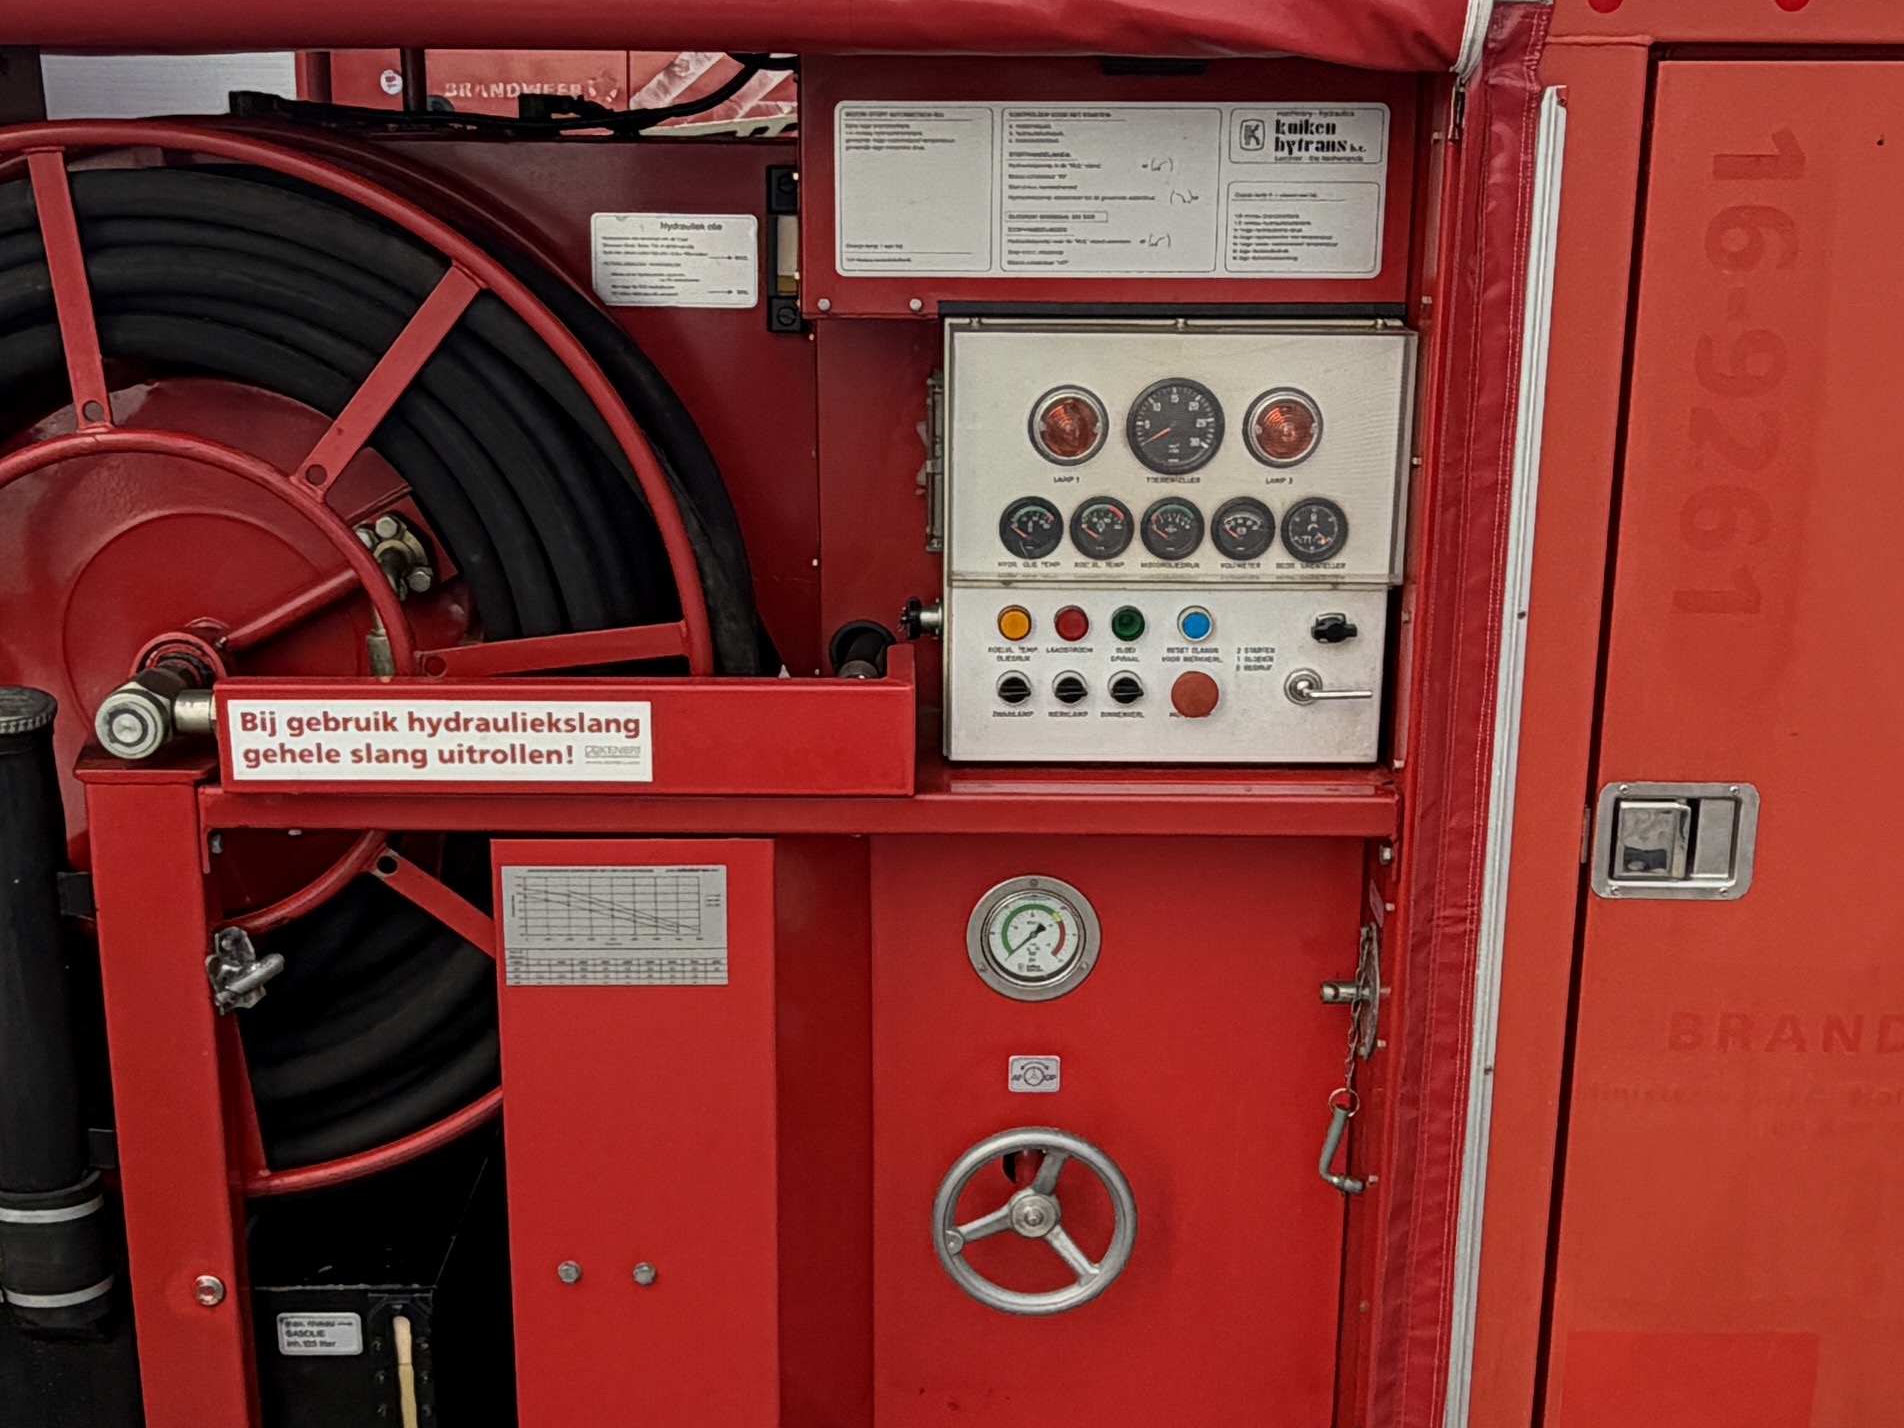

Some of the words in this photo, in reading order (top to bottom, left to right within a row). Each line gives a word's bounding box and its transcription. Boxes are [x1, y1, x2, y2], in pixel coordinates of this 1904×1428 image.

[1275, 119, 1336, 135] kuiken
[1275, 136, 1347, 155] hytrans
[240, 711, 277, 737] Bij
[286, 710, 398, 738] gebruik
[407, 710, 641, 739] hydrauliekslang
[243, 743, 342, 769] gehele
[350, 743, 428, 769] slang
[437, 744, 574, 766] uitrollen!
